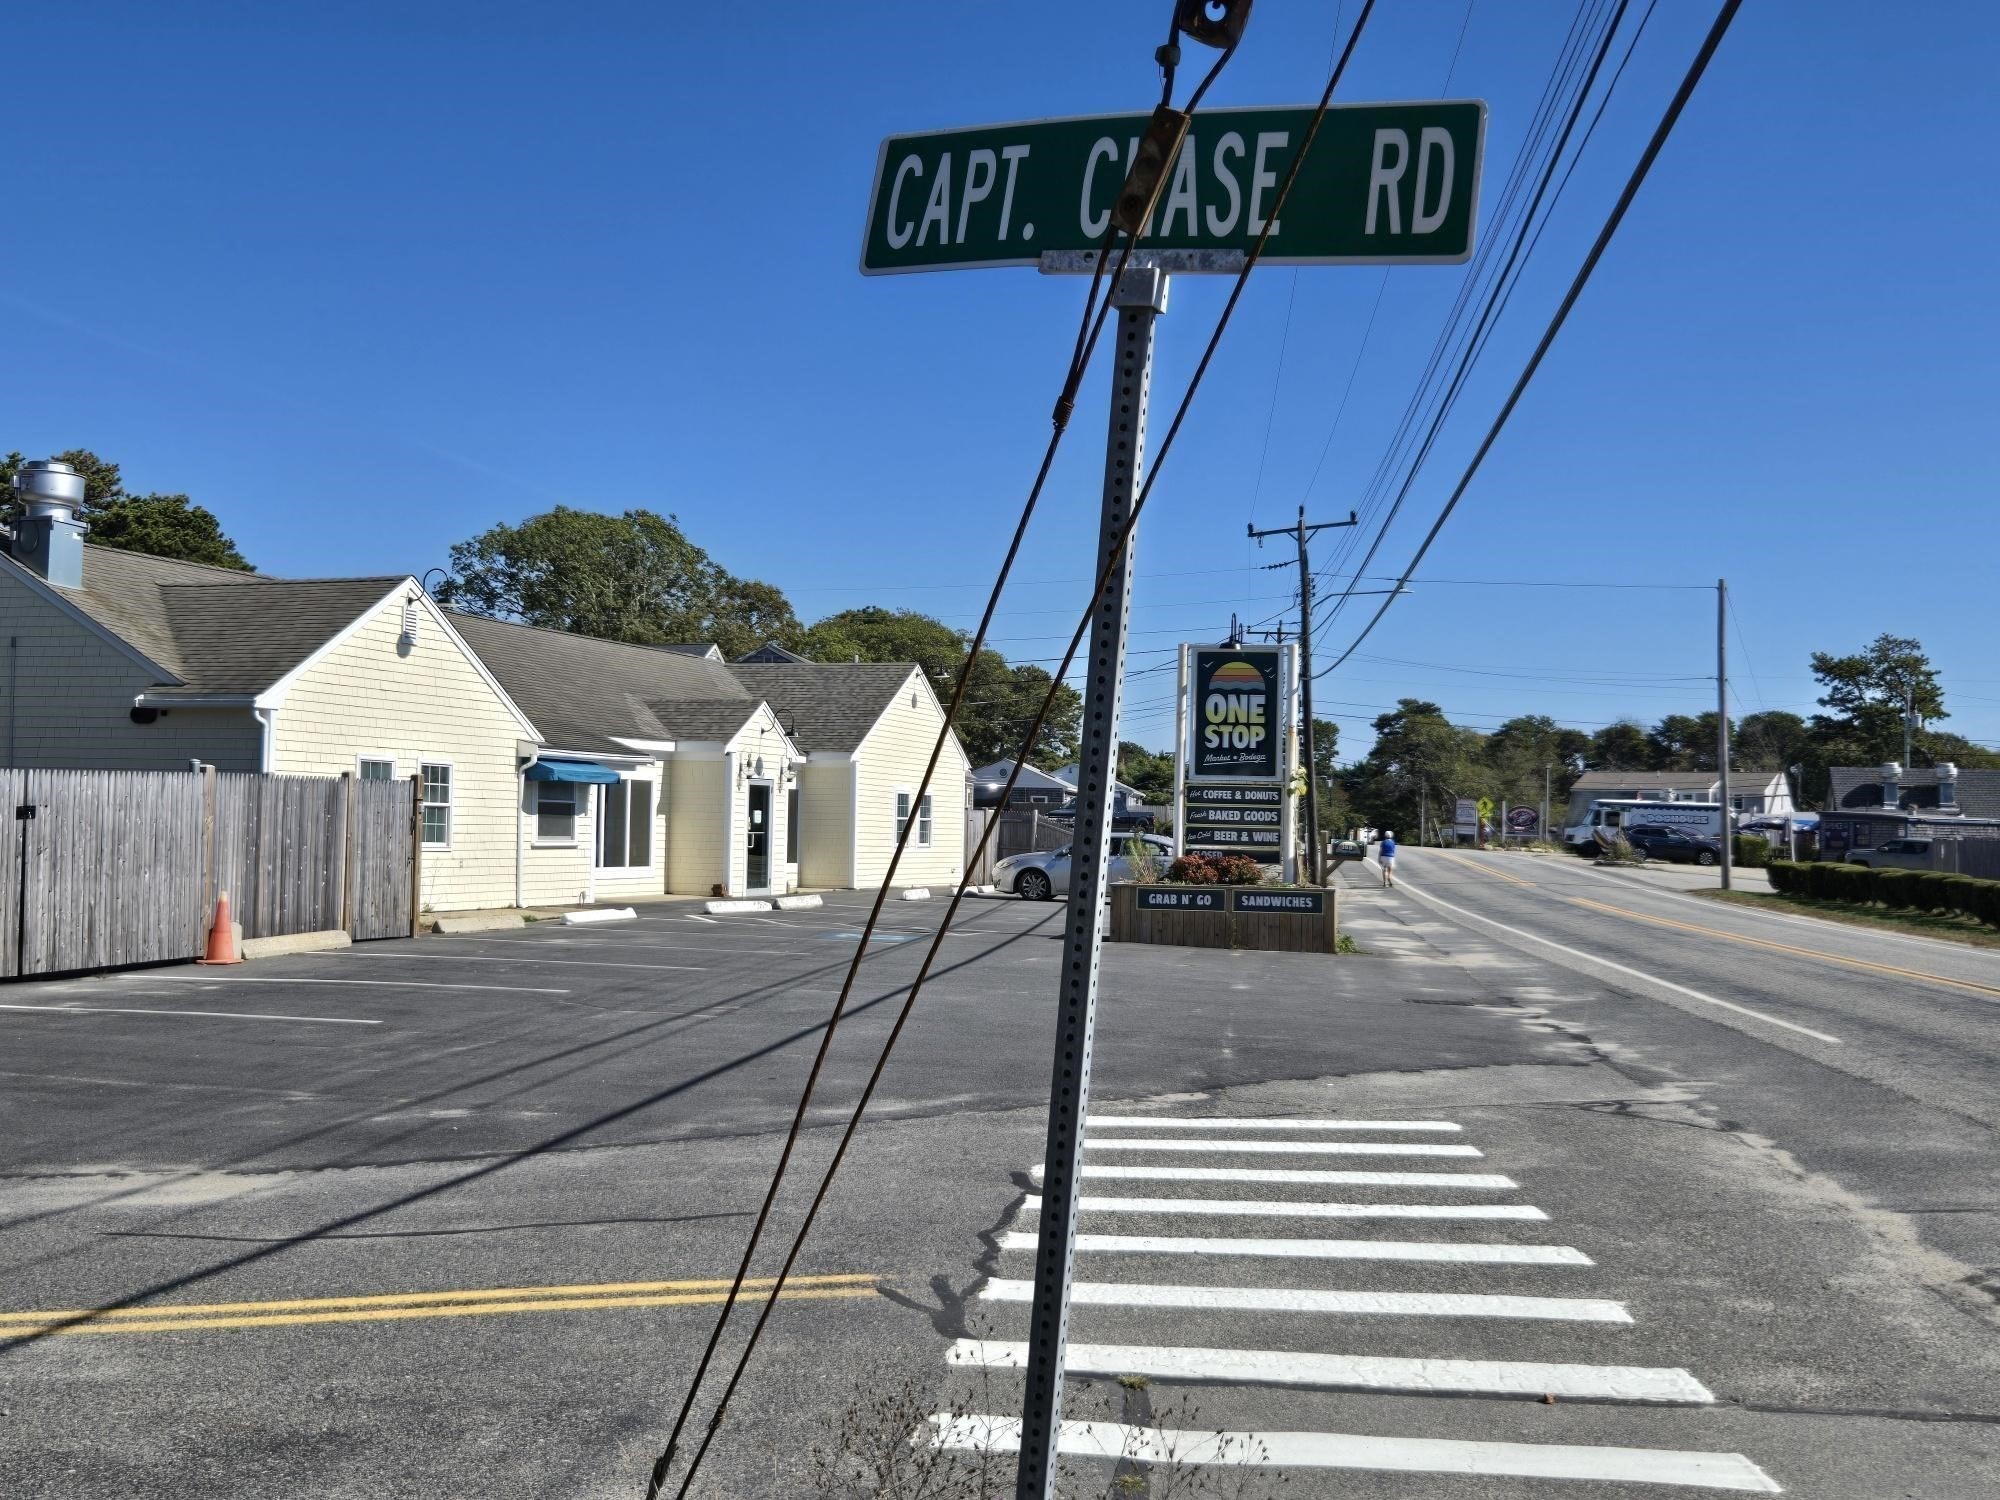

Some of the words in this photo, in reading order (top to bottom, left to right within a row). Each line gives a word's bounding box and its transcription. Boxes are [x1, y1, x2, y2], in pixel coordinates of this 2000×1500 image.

[885, 143, 1034, 250] CAPT.
[1080, 131, 1289, 240] CASE
[1364, 126, 1456, 236] RD
[1205, 693, 1266, 724] ONE
[1204, 724, 1266, 749] STOP
[1203, 753, 1231, 762] Market
[1239, 752, 1267, 764] Bodega
[1189, 790, 1201, 798] Hot
[1202, 789, 1233, 799] COFFEE
[1234, 790, 1242, 800] &
[1244, 791, 1279, 801] DONUTS
[1189, 810, 1207, 819] Fresh
[1208, 810, 1241, 821] BAKED
[1243, 811, 1278, 822] GOODS
[1646, 813, 1709, 824] DOGHOUSE
[1197, 830, 1212, 839] Cold
[1213, 830, 1238, 841] BEER
[1240, 831, 1249, 842] &
[1252, 831, 1279, 842] WINE
[1148, 893, 1177, 905] GRAB
[1196, 894, 1212, 906] GO
[1241, 895, 1313, 908] SANDWICHES
